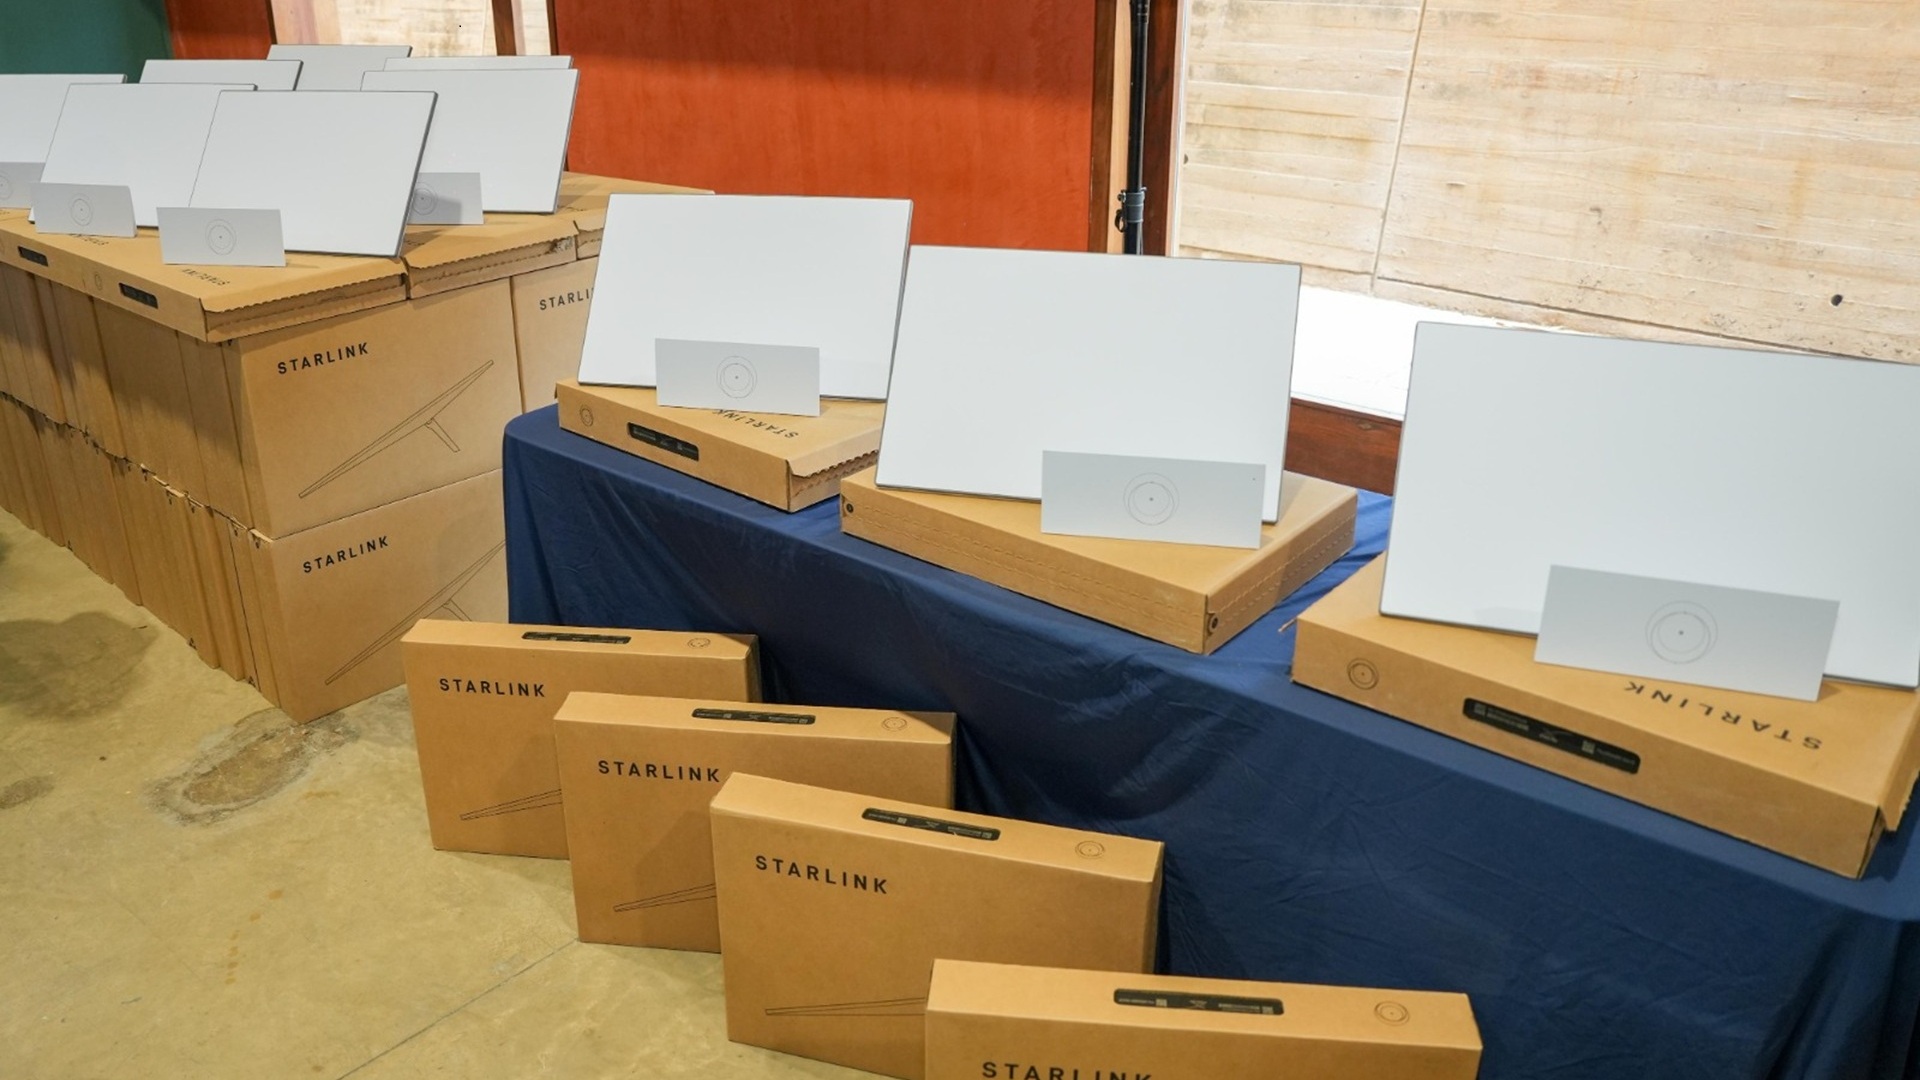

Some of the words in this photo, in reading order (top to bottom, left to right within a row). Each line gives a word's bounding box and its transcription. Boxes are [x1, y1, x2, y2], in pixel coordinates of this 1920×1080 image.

[540, 287, 594, 311] STARLI
[277, 341, 369, 375] STARLINK
[302, 535, 389, 574] STARLINK
[439, 678, 545, 698] STARLINK
[1624, 681, 1823, 750] STARLINK
[597, 759, 720, 783] STARLINK
[755, 854, 888, 895] STARLINK
